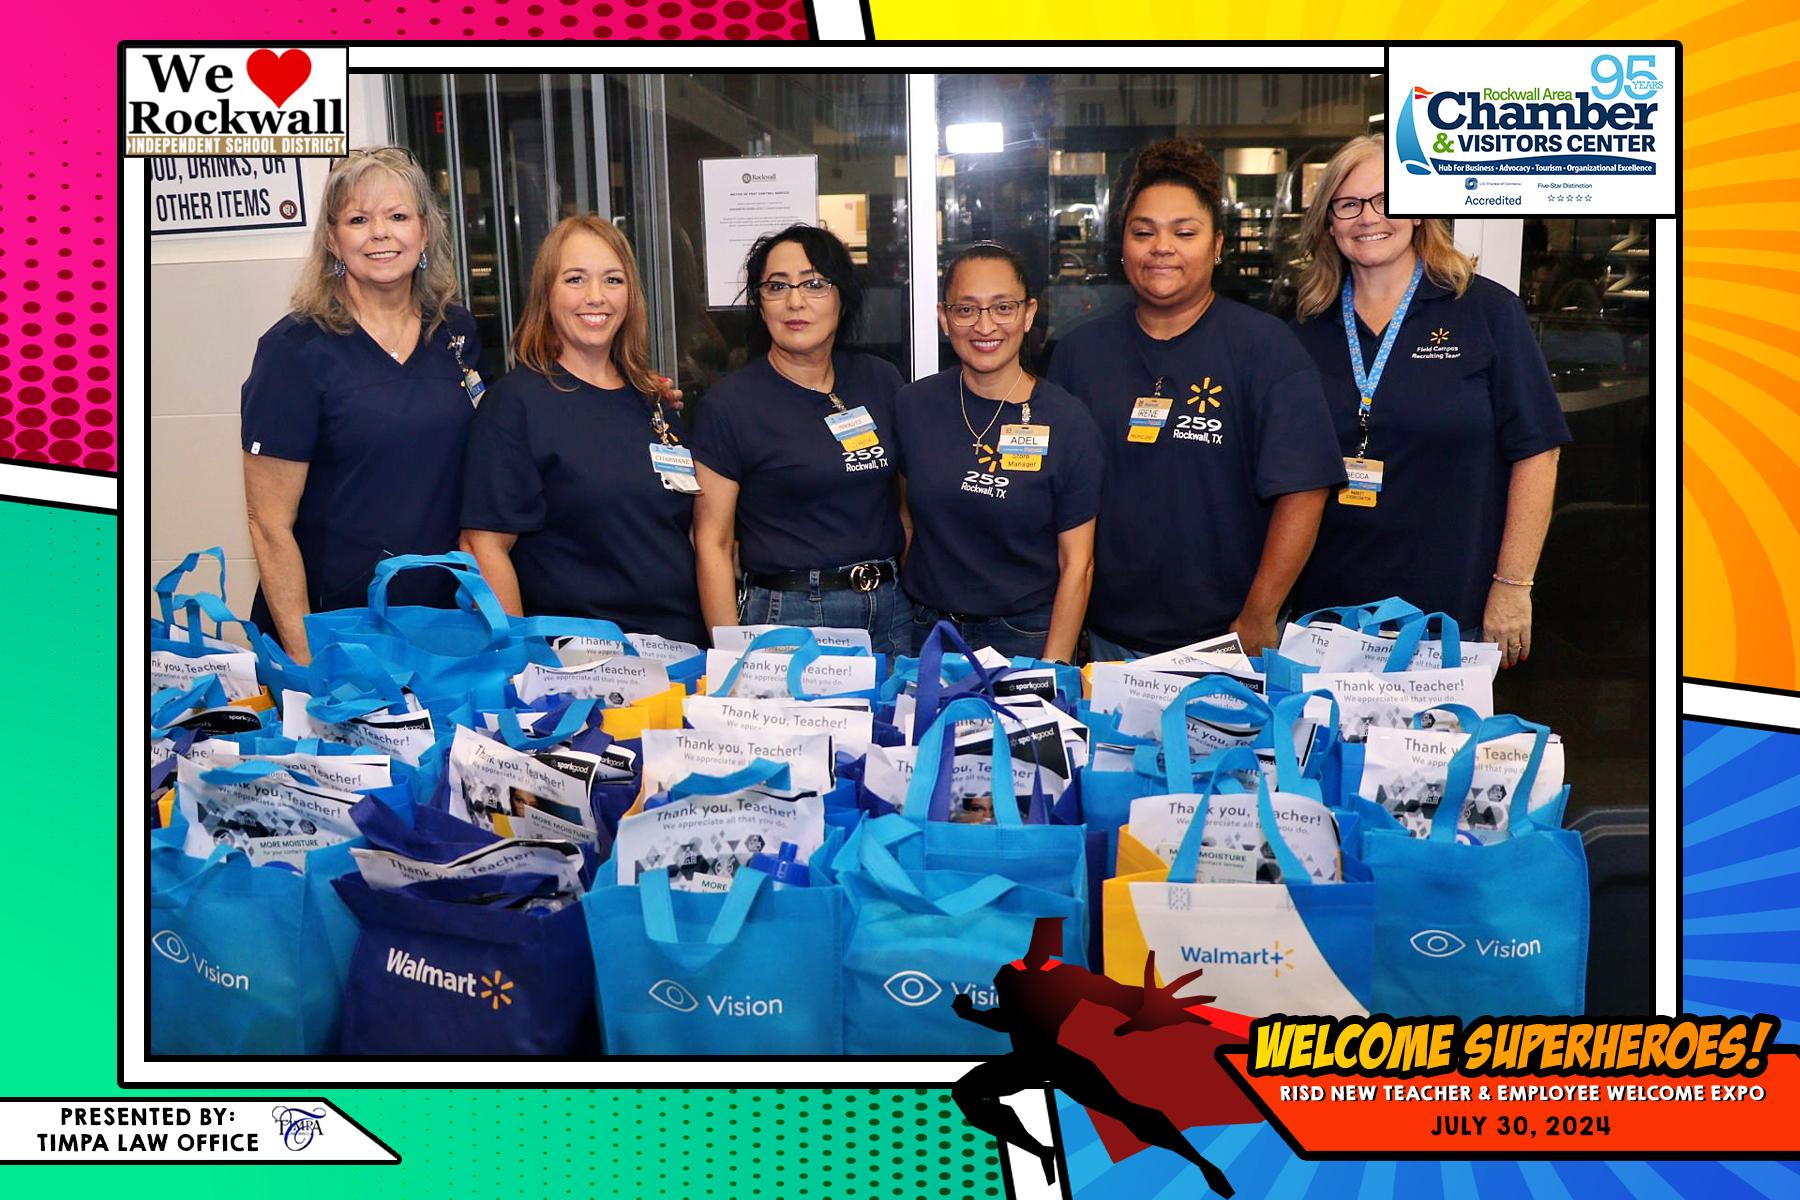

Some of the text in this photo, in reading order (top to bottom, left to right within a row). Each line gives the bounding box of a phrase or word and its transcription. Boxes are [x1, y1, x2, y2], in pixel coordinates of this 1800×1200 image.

[156, 188, 271, 222] OTHER ITEMS
[1412, 352, 1444, 360] Recruiting
[1138, 409, 1159, 418] IRENE
[1176, 415, 1222, 432] 259
[1010, 436, 1038, 445] ADEL
[1173, 428, 1223, 444] Rockwall, TX
[842, 446, 885, 463] 259
[846, 457, 889, 472] Rockwall, TX
[963, 470, 1010, 488] 259
[960, 481, 1007, 499] Rockwall, TX
[640, 639, 683, 653] Teacher!
[164, 663, 184, 672] you,
[184, 662, 231, 674] Teacher!
[600, 665, 646, 677] Teacher!
[1015, 681, 1049, 691] sparkgood
[1123, 673, 1160, 690] Thank
[1335, 679, 1464, 694] Thank you, Teacher!
[1128, 688, 1140, 696] We
[1357, 695, 1398, 704] appreciate
[1428, 696, 1443, 704] you
[1444, 694, 1457, 702] do.
[721, 704, 848, 729] Thank you, Teacher!
[726, 720, 739, 728] We
[362, 727, 410, 746] Teacher!
[1201, 731, 1229, 747] you,
[676, 736, 803, 757] Thank you, Teacher!
[1404, 737, 1447, 755] Thank
[684, 752, 695, 760] We
[696, 753, 736, 766] appreciate
[1412, 755, 1425, 764] We
[1485, 764, 1502, 773] that
[1503, 766, 1518, 775] you
[310, 764, 361, 786] Teacher!
[475, 744, 566, 791] Thank you, Teacher!
[557, 761, 589, 774] sparkgood
[254, 784, 284, 800] you,
[286, 791, 341, 819] Teacher!
[656, 799, 797, 821] Thank you, Teacher!
[1219, 805, 1250, 818] you,
[531, 813, 551, 827] MORE
[553, 822, 590, 840] MOISTURE
[662, 822, 675, 830] We
[677, 817, 724, 829] appreciate
[737, 815, 756, 824] that
[759, 818, 774, 826] you
[260, 839, 319, 849] MORE MOISTURE
[1199, 851, 1247, 863] MOISTURE
[387, 858, 431, 877] Thank
[701, 879, 728, 891] MORE
[1474, 938, 1541, 959] Vision
[192, 951, 250, 991] Vision
[386, 947, 477, 997] Walmart
[706, 994, 783, 1017] Vision
